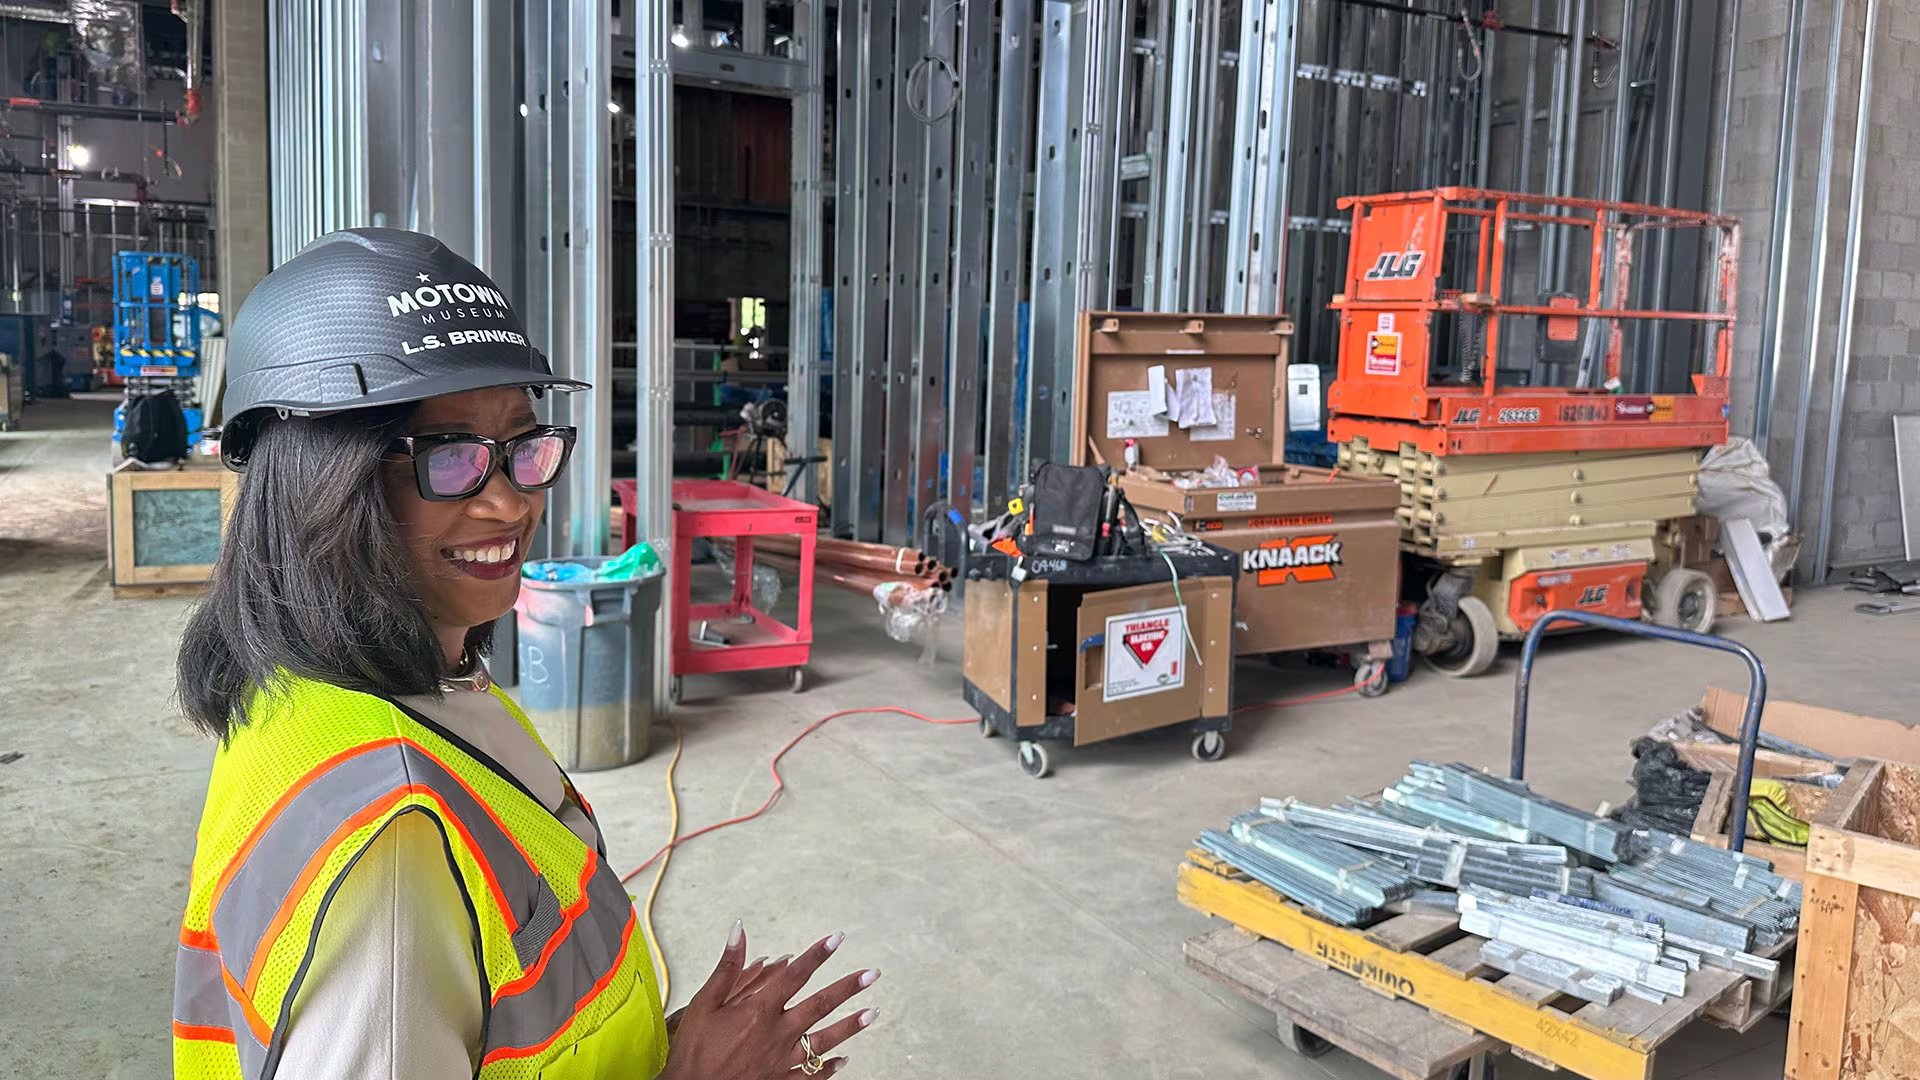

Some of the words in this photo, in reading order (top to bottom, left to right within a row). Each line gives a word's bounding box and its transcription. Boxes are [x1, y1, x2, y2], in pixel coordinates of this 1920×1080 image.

[1366, 252, 1423, 279] JLG
[386, 283, 508, 317] MOTOWN
[421, 308, 505, 325] MUSEUM
[401, 335, 446, 355] L.S.
[448, 329, 527, 347] BRINKER
[1452, 408, 1480, 423] JLG
[1242, 542, 1341, 571] KNAACK
[1577, 585, 1609, 606] JLG
[1125, 618, 1169, 632] TRIANGLE
[1317, 941, 1415, 996] QUIKRETE
